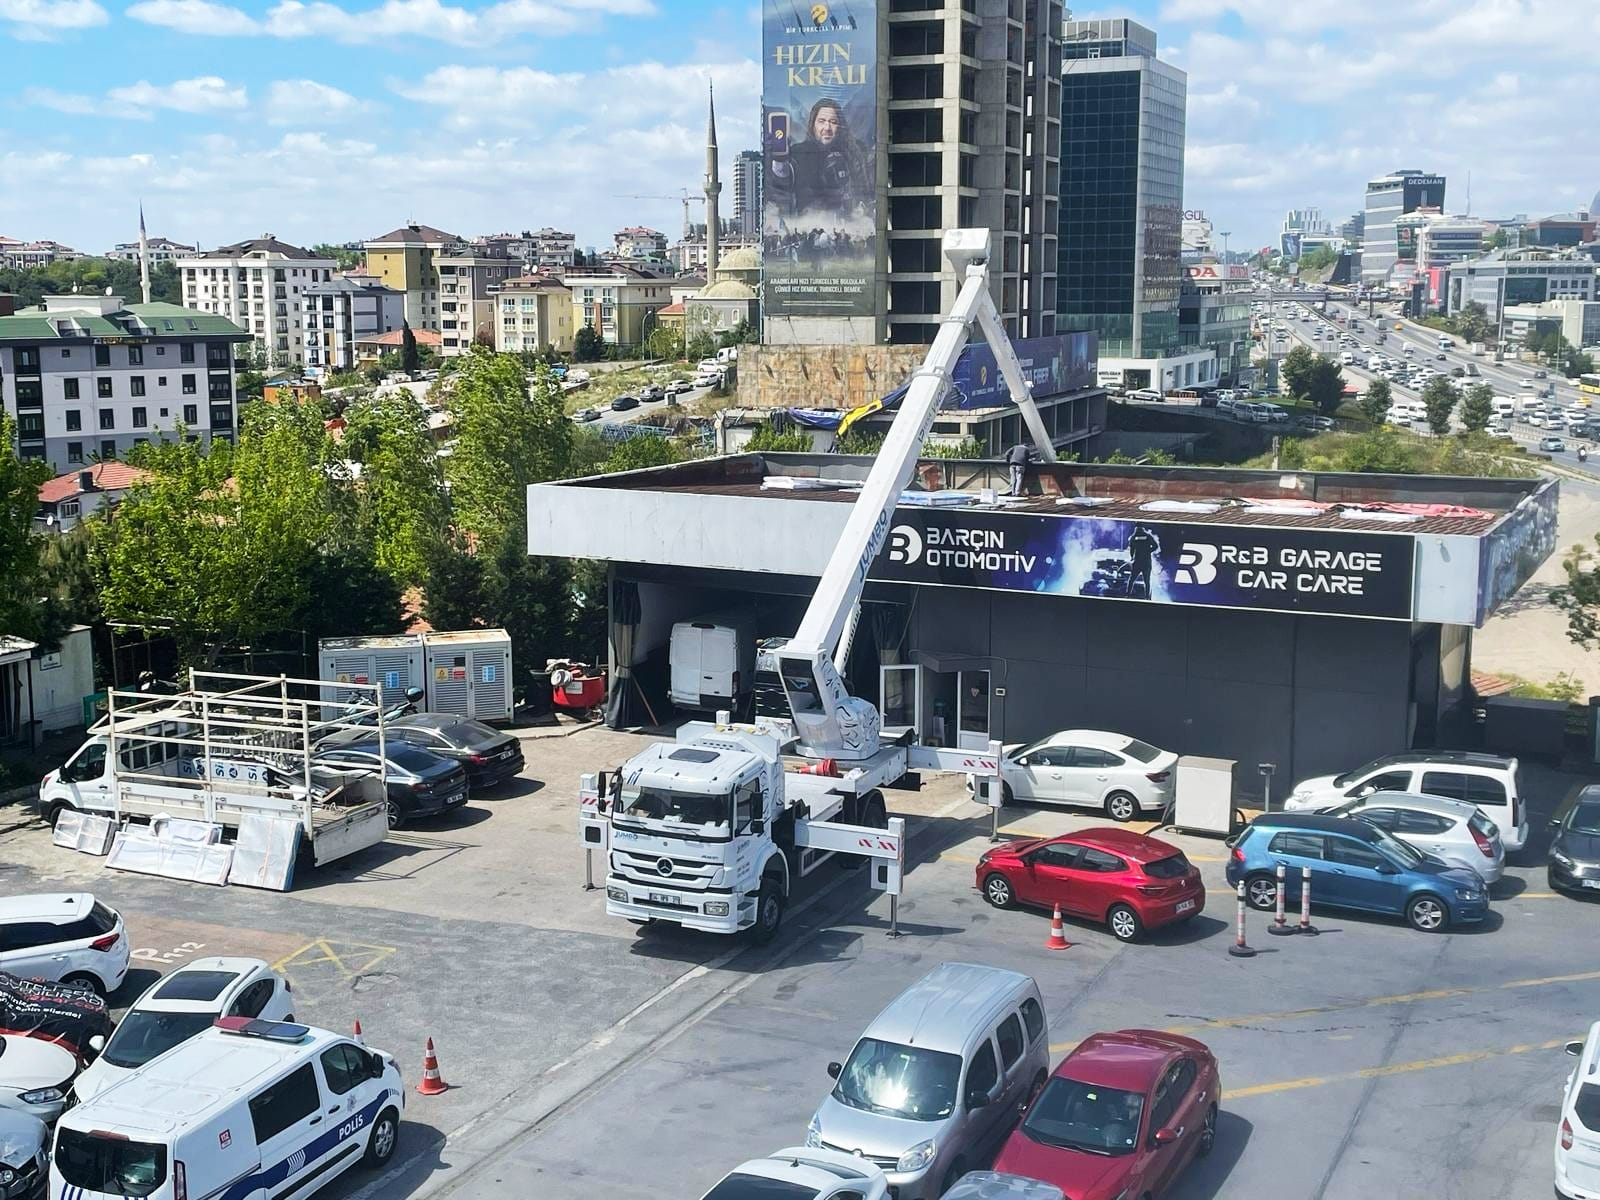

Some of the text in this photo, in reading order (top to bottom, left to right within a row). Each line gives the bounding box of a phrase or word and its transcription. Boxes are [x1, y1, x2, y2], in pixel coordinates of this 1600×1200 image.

[772, 42, 852, 65] HIZIN
[787, 64, 867, 87] KRALI
[859, 509, 887, 582] JUMBO
[926, 527, 1004, 551] BARÇIN
[926, 549, 1037, 573] OTOMOTİV
[1220, 545, 1382, 572] R&B GARAGE
[1237, 570, 1364, 596] CAR CARE
[614, 831, 639, 840] JUMBO
[338, 1114, 364, 1141] POLİS
